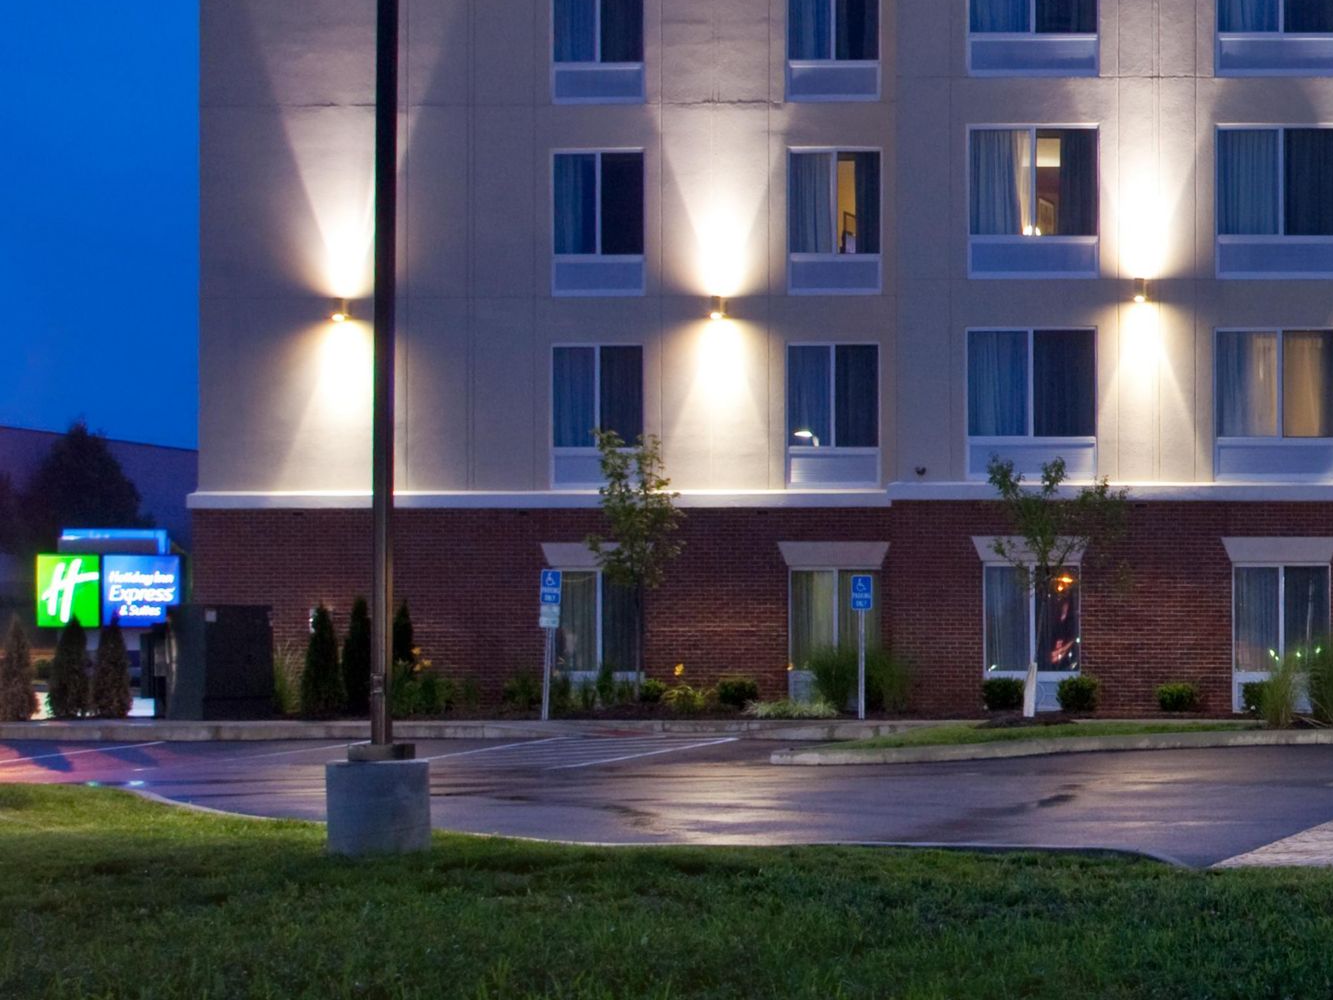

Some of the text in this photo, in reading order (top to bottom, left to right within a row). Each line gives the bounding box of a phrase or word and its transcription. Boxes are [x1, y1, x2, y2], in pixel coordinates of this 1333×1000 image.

[108, 570, 174, 586] Holiday Inn
[108, 584, 176, 606] Express
[118, 604, 161, 616] & Suites
